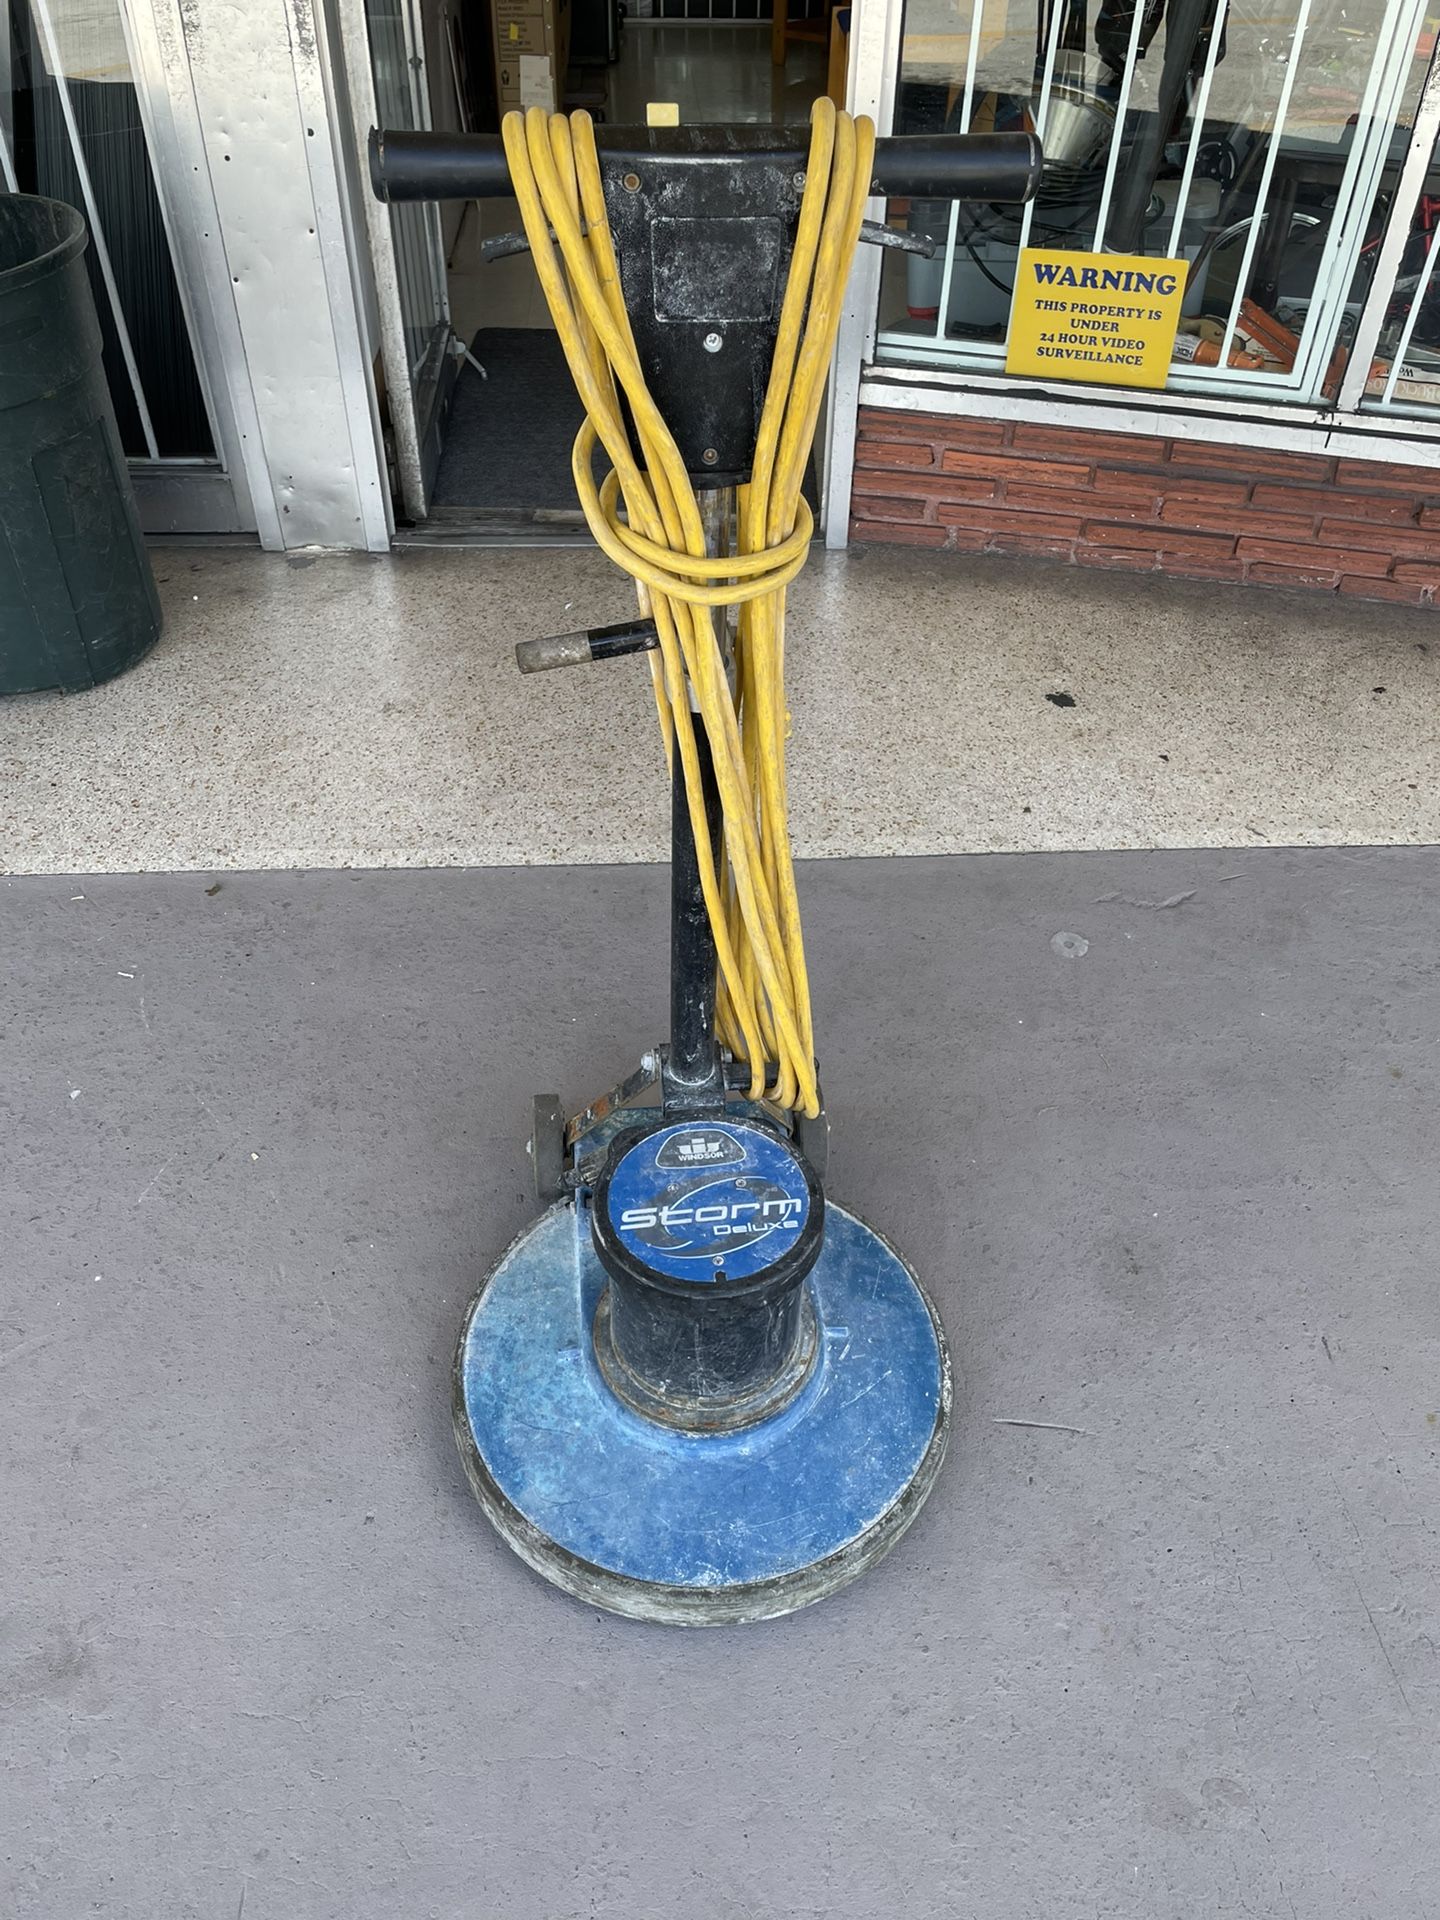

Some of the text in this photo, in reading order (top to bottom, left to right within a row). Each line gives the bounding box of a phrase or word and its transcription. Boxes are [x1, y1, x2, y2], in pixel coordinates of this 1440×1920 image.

[1034, 263, 1176, 295] WARNING
[1034, 299, 1162, 321] THIS PROPERTY IS
[1070, 318, 1119, 332] UNDER
[1039, 332, 1145, 350] 24 HOUR VIDEO
[1036, 346, 1143, 366] SURVEILLANCE
[678, 1152, 724, 1162] WINDSOR
[713, 1220, 799, 1236] Deluxe
